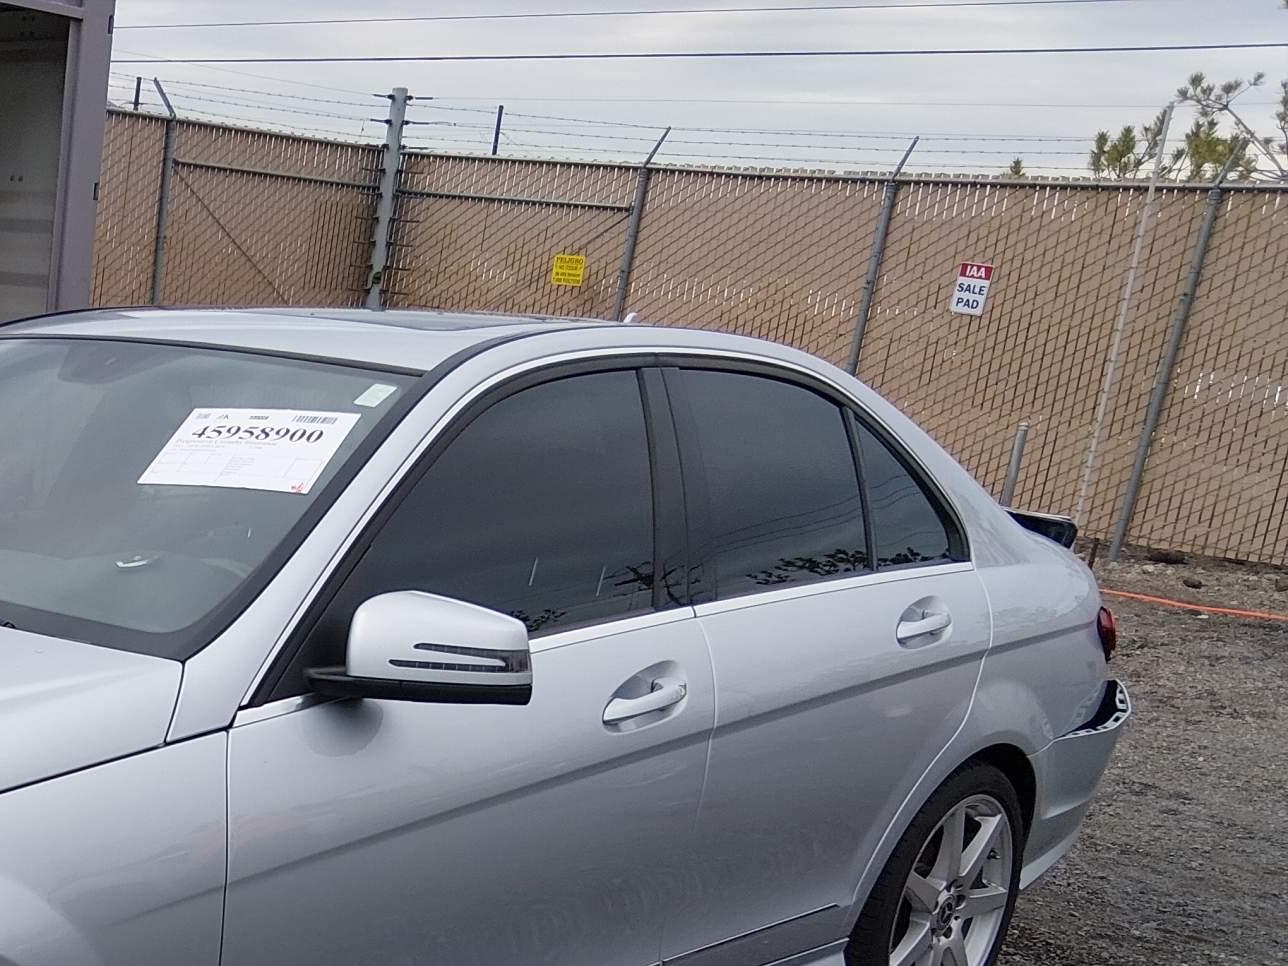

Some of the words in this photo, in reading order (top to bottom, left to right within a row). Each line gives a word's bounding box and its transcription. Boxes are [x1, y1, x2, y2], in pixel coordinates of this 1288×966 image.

[556, 257, 584, 265] PELIGRO
[966, 265, 986, 278] IAA
[957, 283, 986, 296] SALE
[956, 297, 979, 309] PAD
[191, 425, 324, 443] 45958900
